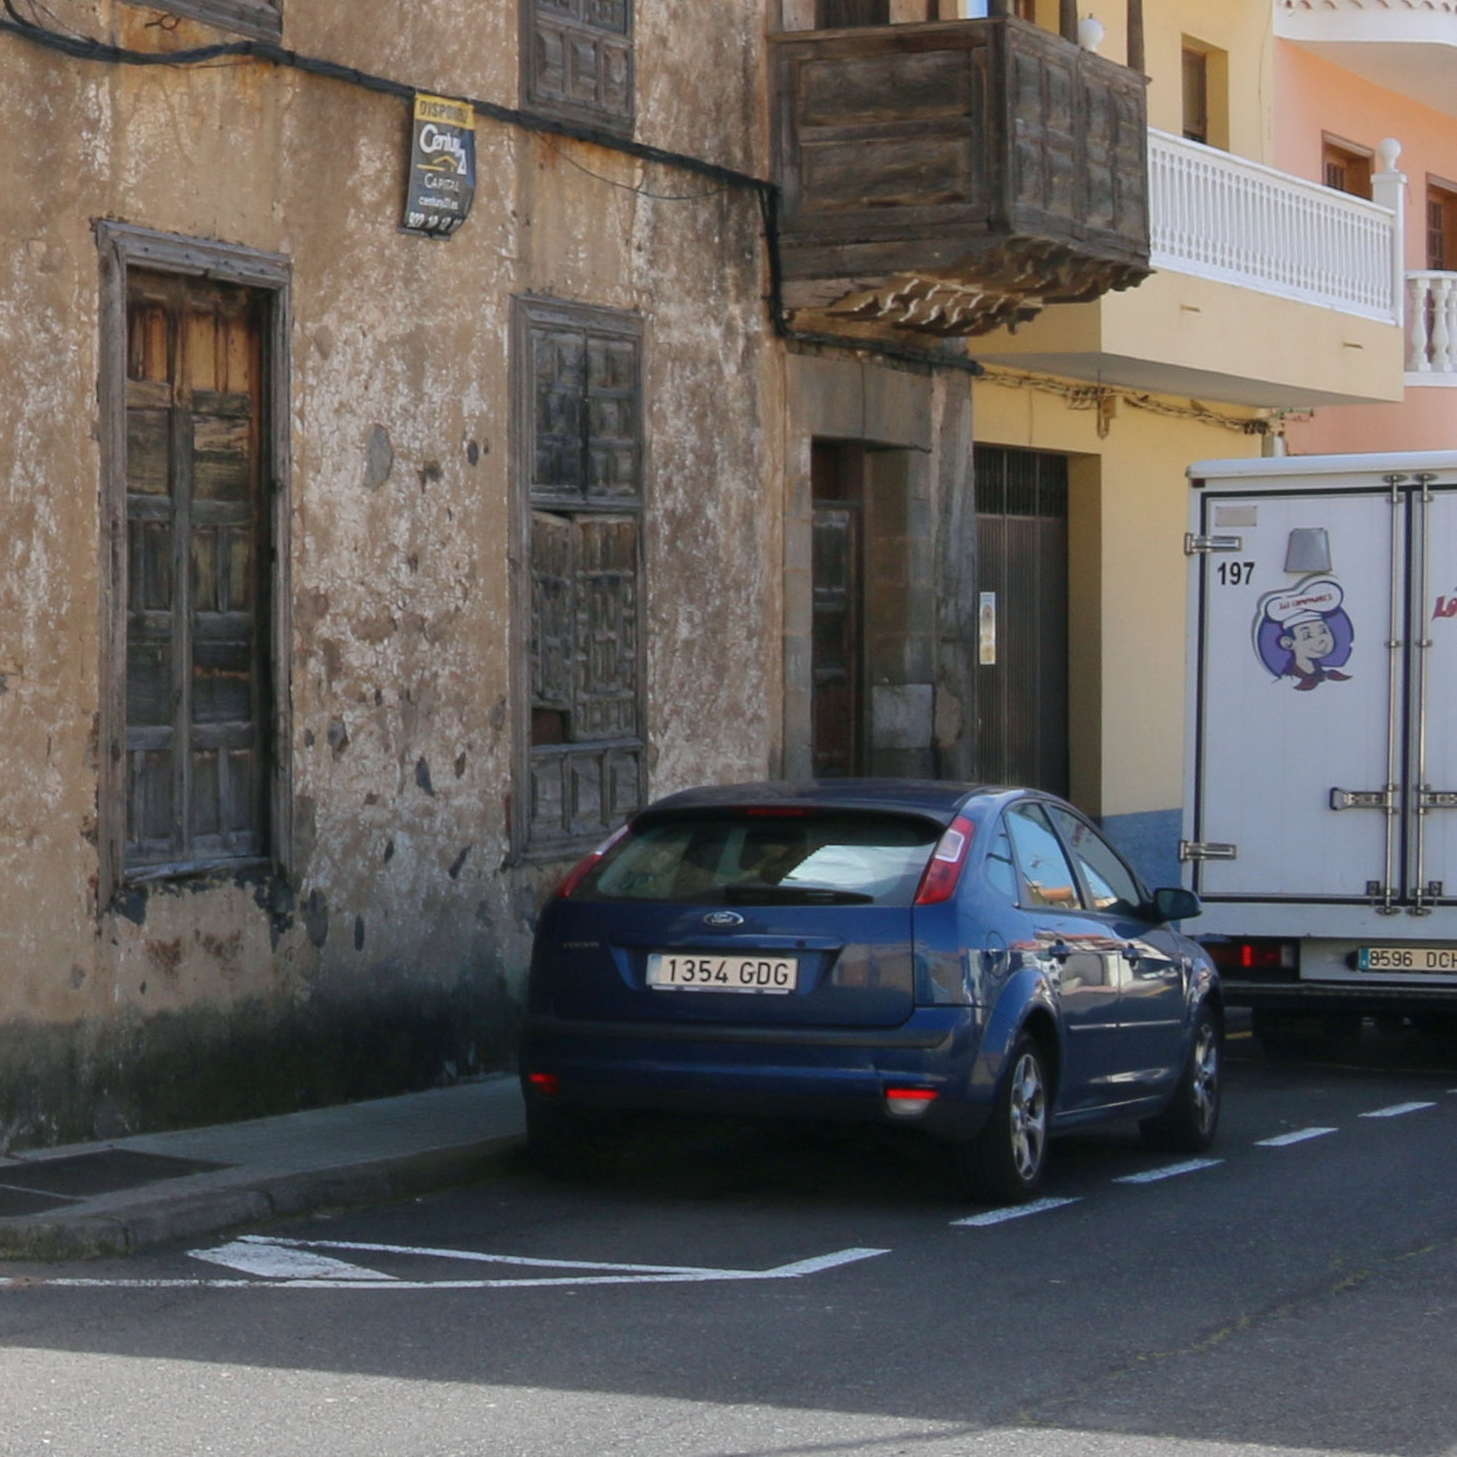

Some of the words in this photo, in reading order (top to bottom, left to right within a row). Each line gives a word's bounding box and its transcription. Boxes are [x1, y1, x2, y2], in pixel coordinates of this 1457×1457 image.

[1217, 562, 1255, 585] 197
[1369, 950, 1413, 967] 8596
[668, 959, 729, 984] 1354
[739, 961, 788, 985] GDG
